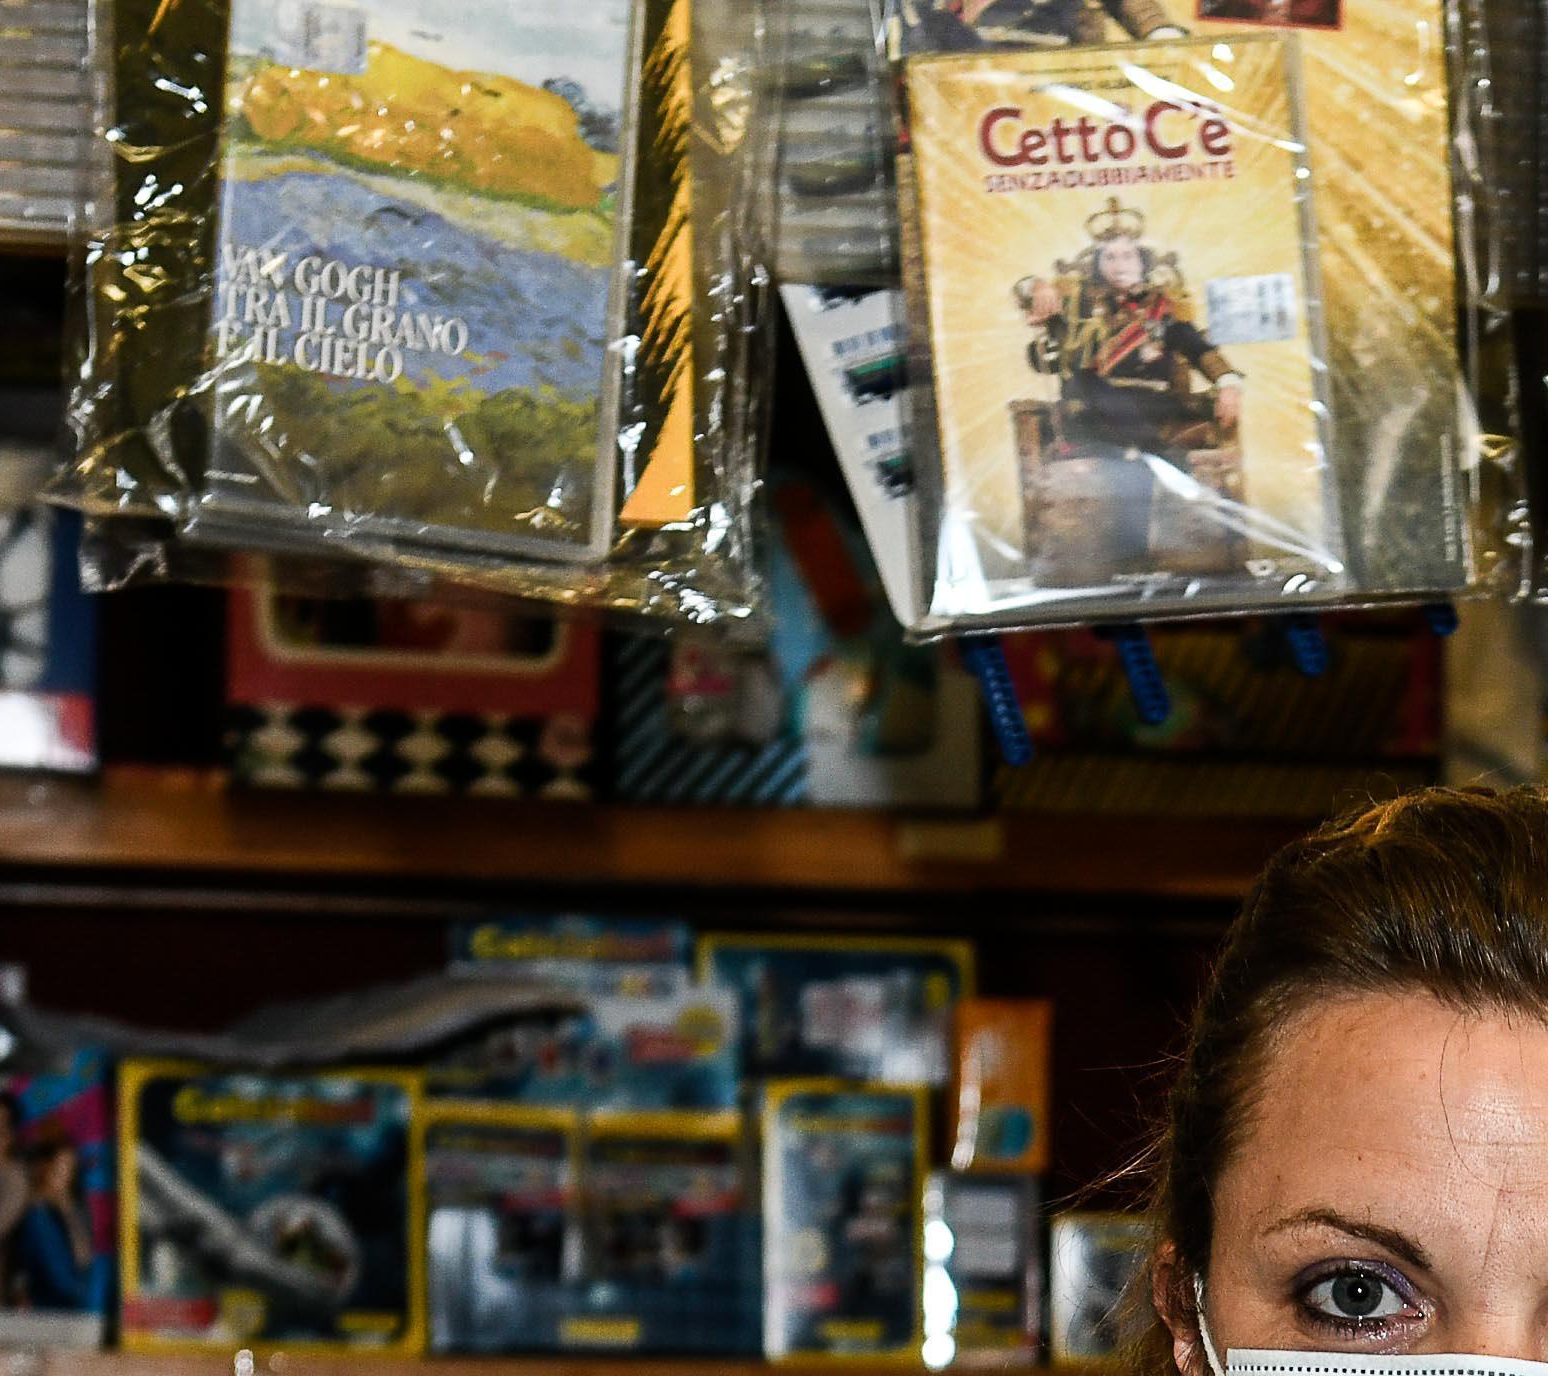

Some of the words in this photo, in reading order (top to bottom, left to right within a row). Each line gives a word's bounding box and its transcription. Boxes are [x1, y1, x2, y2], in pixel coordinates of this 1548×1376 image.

[979, 105, 1133, 172] Cetto
[222, 243, 287, 289] VAN
[295, 253, 401, 308] GOGH
[219, 282, 289, 330] TRA
[298, 291, 333, 335] IL
[342, 299, 471, 358] GRANO
[250, 322, 287, 366] IL
[295, 330, 404, 384] CIELO
